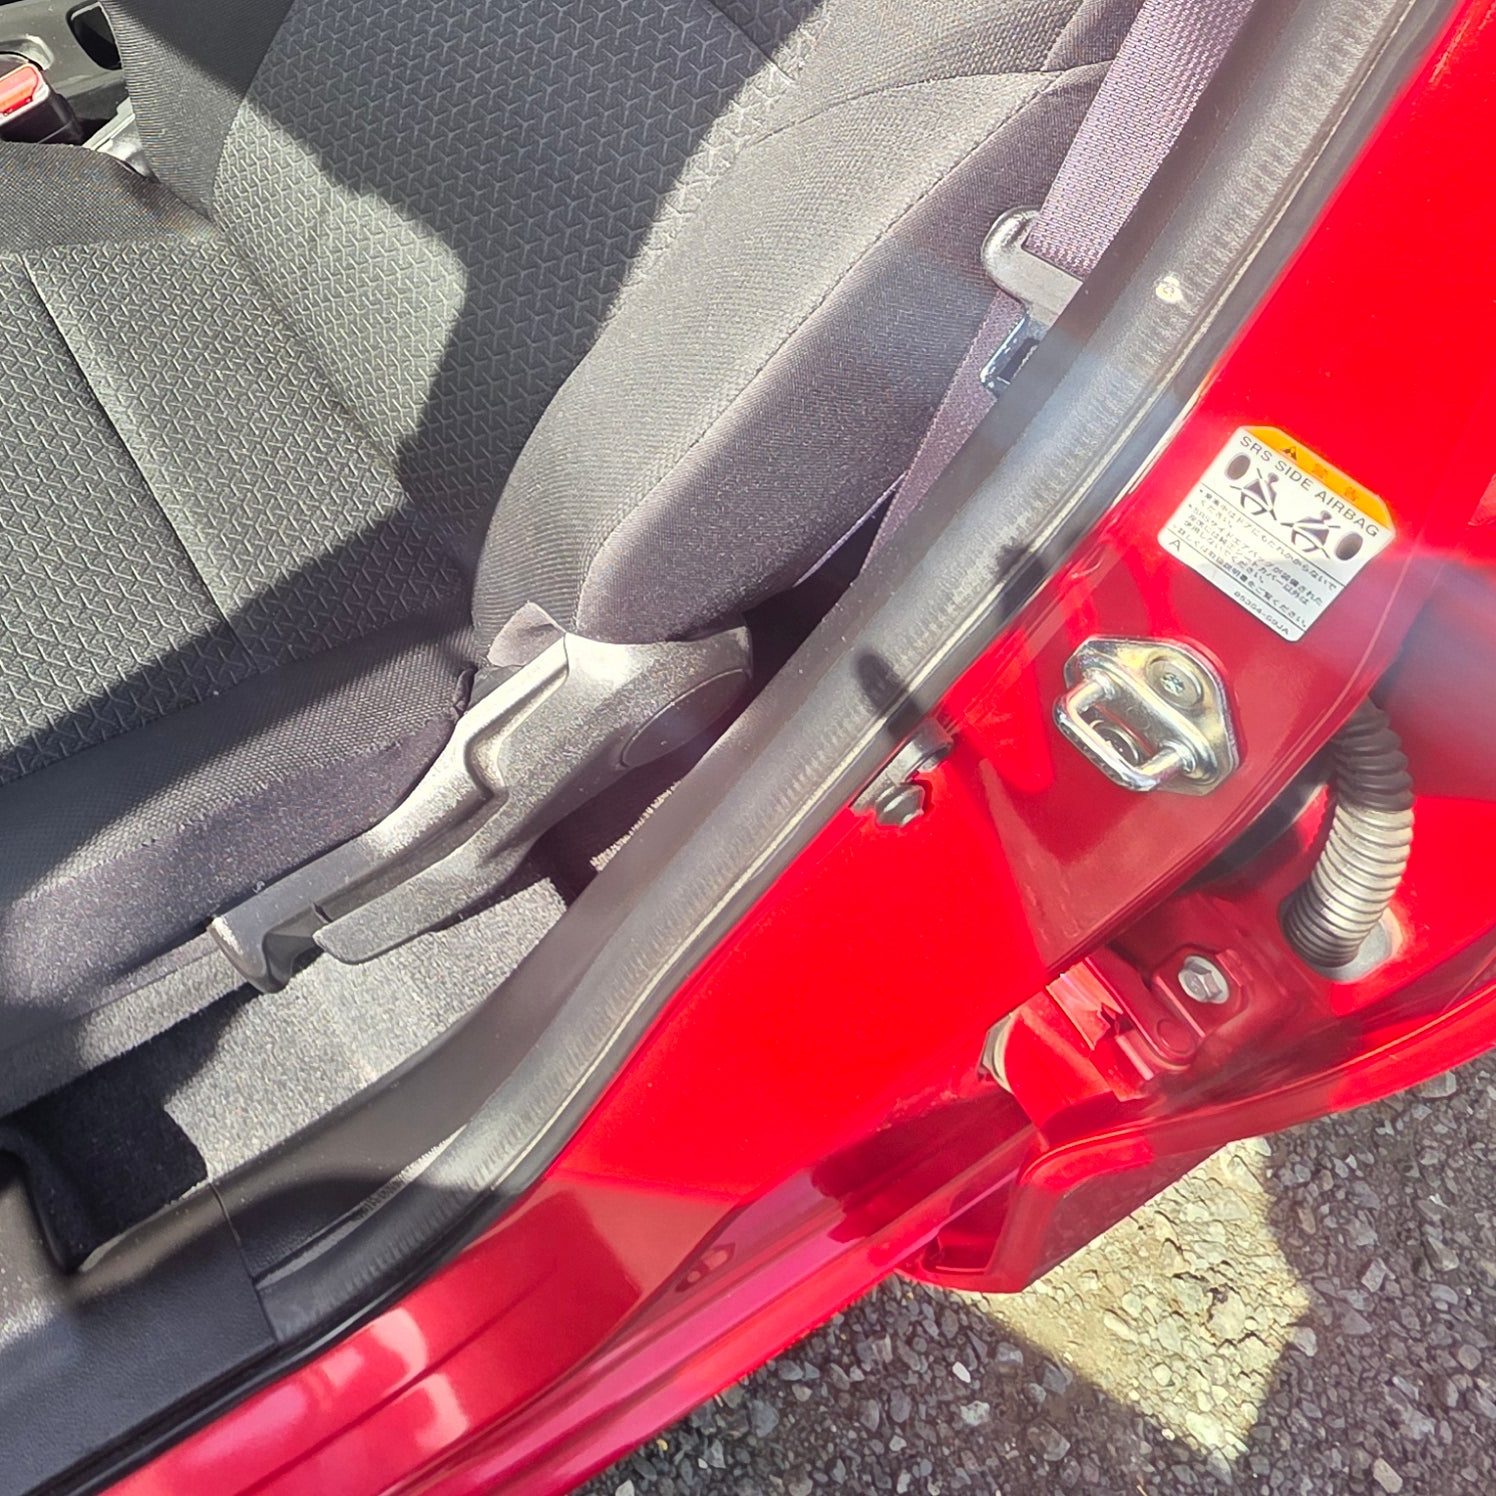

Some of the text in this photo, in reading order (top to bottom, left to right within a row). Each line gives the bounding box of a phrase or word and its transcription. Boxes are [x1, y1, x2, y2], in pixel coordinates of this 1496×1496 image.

[1239, 435, 1380, 538] SRS SIDE AIRBAG
[1168, 538, 1183, 553] A
